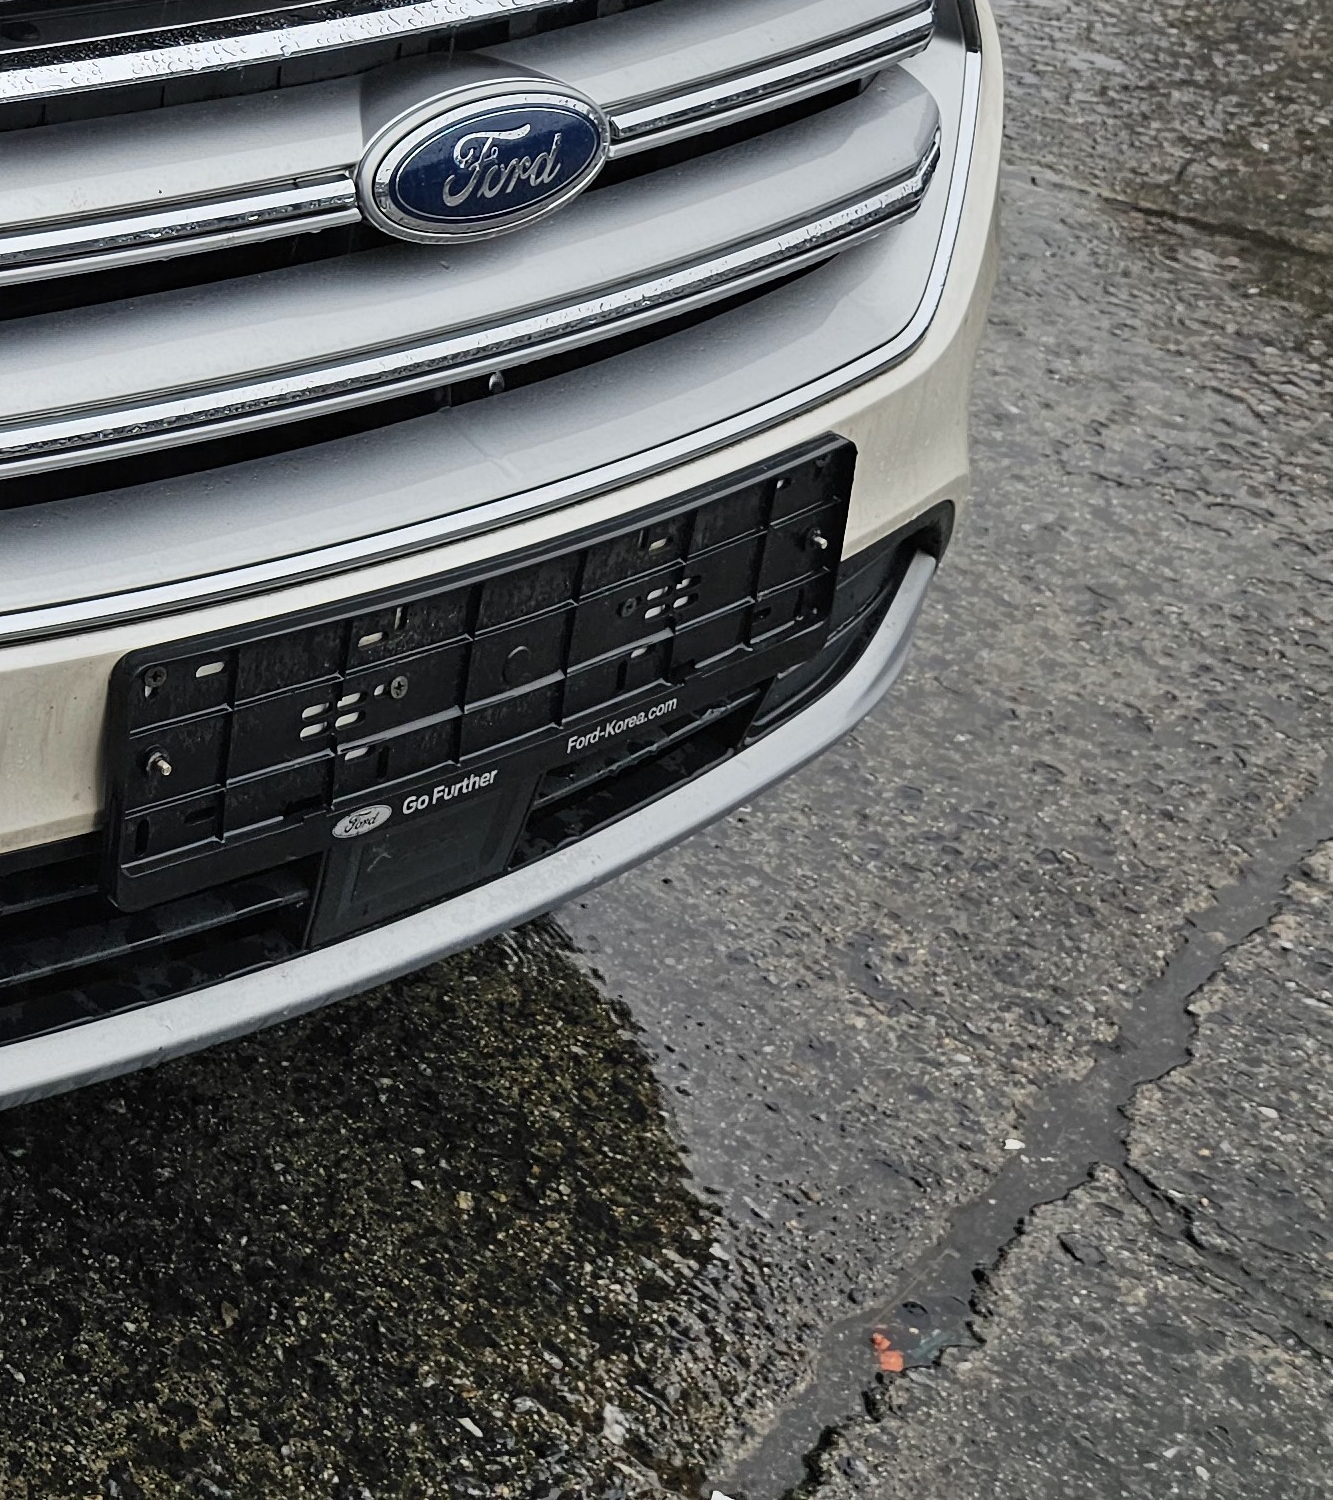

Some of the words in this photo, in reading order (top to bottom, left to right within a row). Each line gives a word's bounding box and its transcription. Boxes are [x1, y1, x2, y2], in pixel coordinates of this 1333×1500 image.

[442, 123, 562, 207] Ford
[566, 698, 678, 754] Ford-Korea.com
[344, 812, 379, 833] Ford
[402, 794, 429, 815] Go
[432, 769, 498, 804] Further
